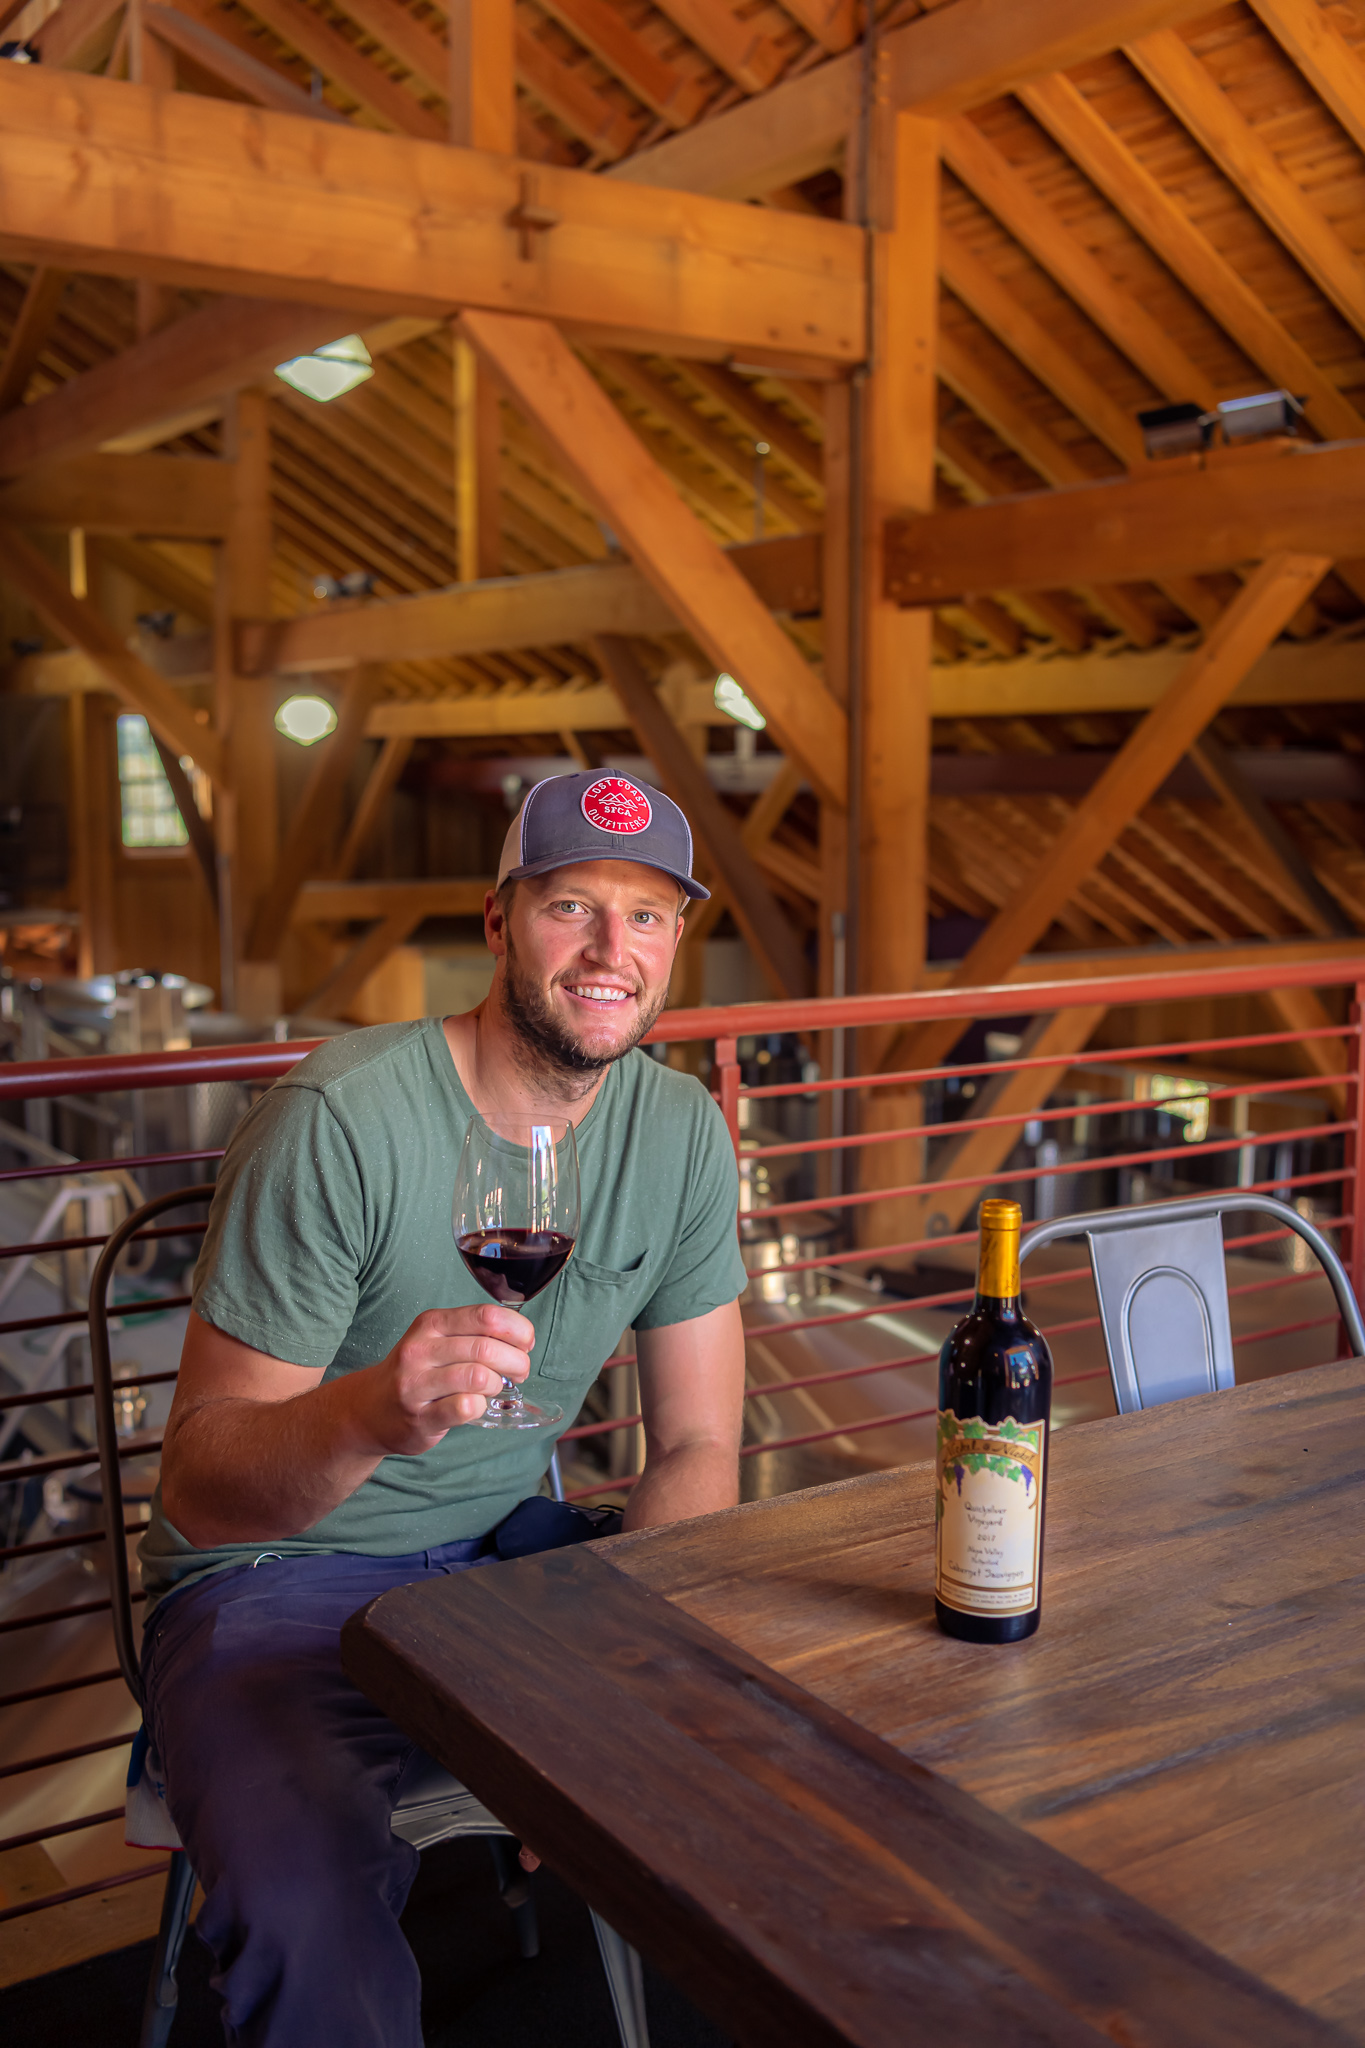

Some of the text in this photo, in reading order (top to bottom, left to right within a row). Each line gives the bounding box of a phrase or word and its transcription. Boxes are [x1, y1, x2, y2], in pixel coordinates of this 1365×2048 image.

[587, 779, 647, 808] LOST COAST
[588, 808, 646, 831] OUTFITTERS
[604, 806, 632, 818] SFCA
[967, 1514, 1004, 1530] Vineyard
